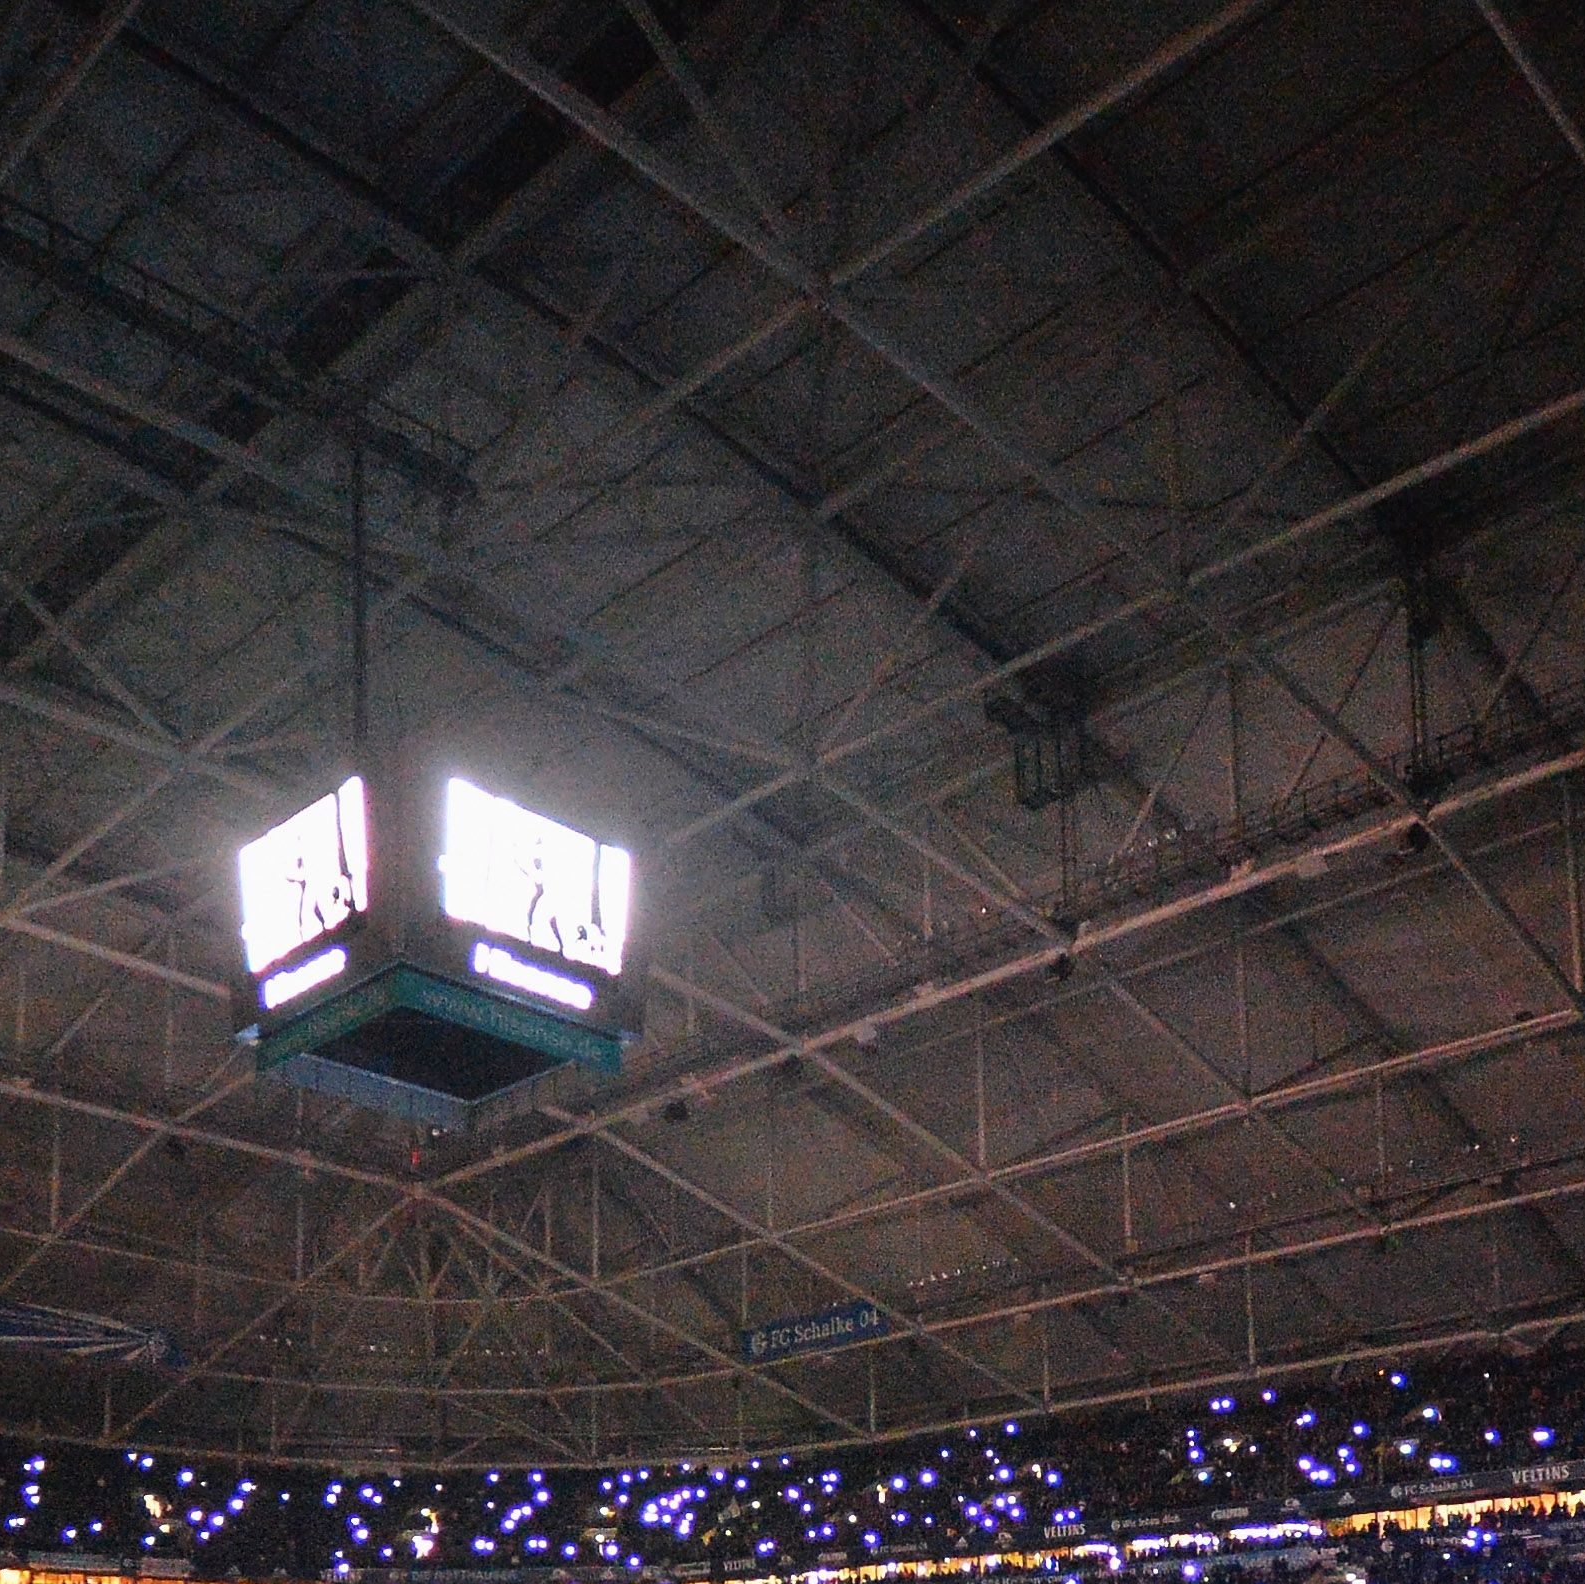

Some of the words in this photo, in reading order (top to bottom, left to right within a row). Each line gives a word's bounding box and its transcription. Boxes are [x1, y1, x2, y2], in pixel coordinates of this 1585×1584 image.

[770, 1327, 791, 1349] FC
[793, 1316, 854, 1344] Schalke
[859, 1308, 880, 1328] 04
[1511, 1464, 1570, 1486] VELTINS
[1043, 1523, 1086, 1540] VELTINS
